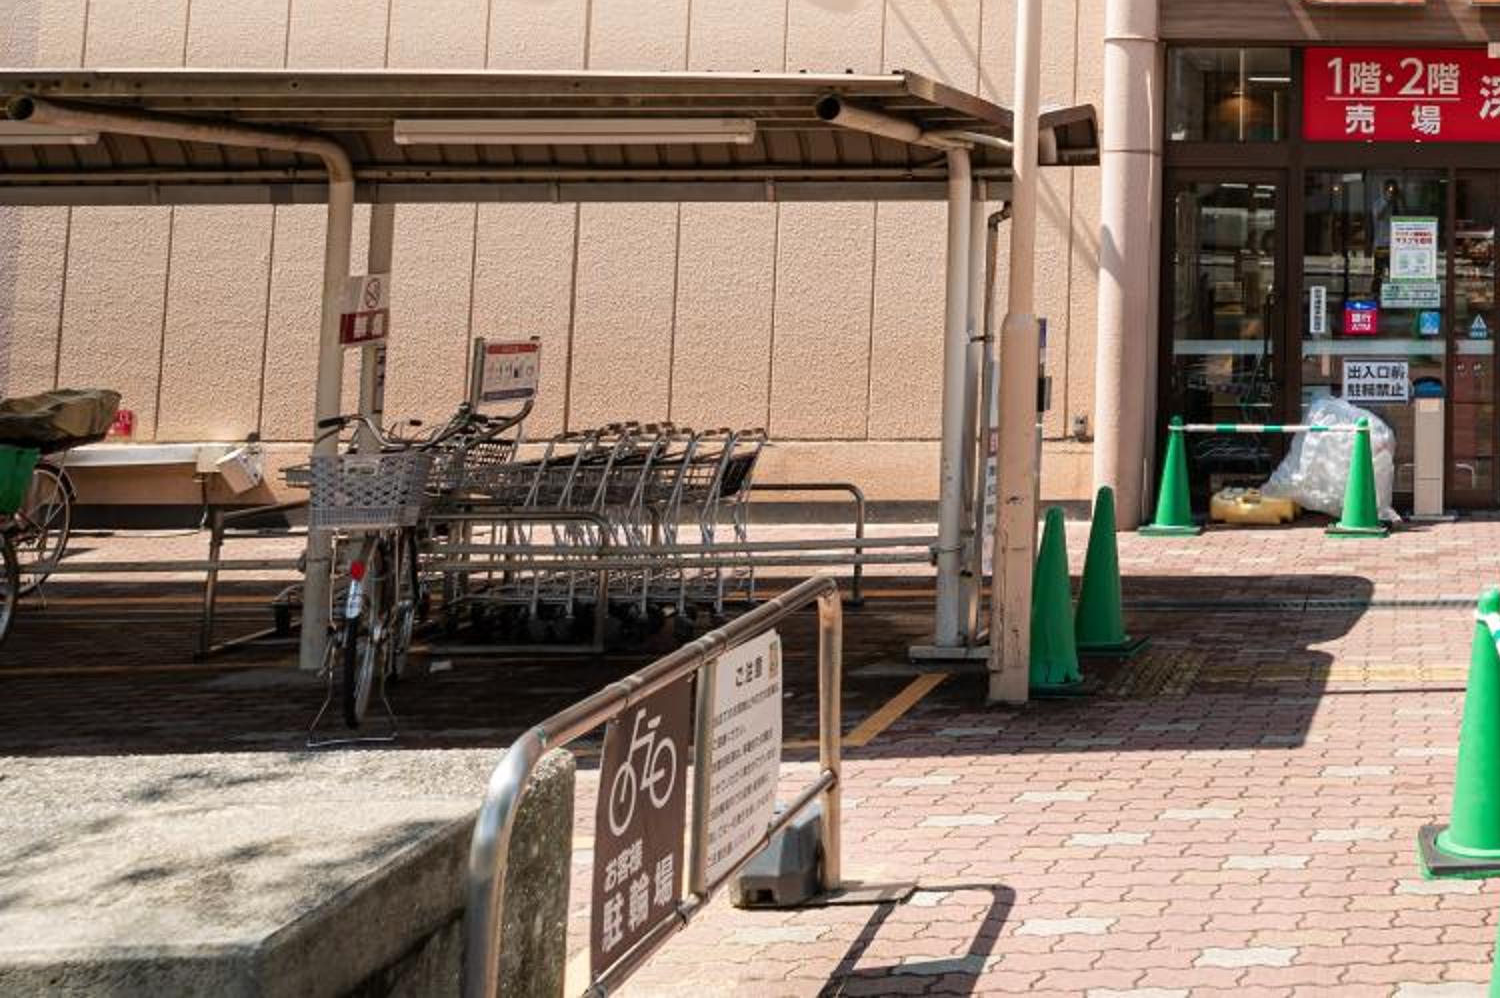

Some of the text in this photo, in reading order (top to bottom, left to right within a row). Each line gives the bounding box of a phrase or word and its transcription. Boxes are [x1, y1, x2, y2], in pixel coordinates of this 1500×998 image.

[1347, 364, 1405, 380] 出入口前
[1347, 383, 1404, 397] 駐輪禁止
[602, 853, 674, 954] 駐輪場
